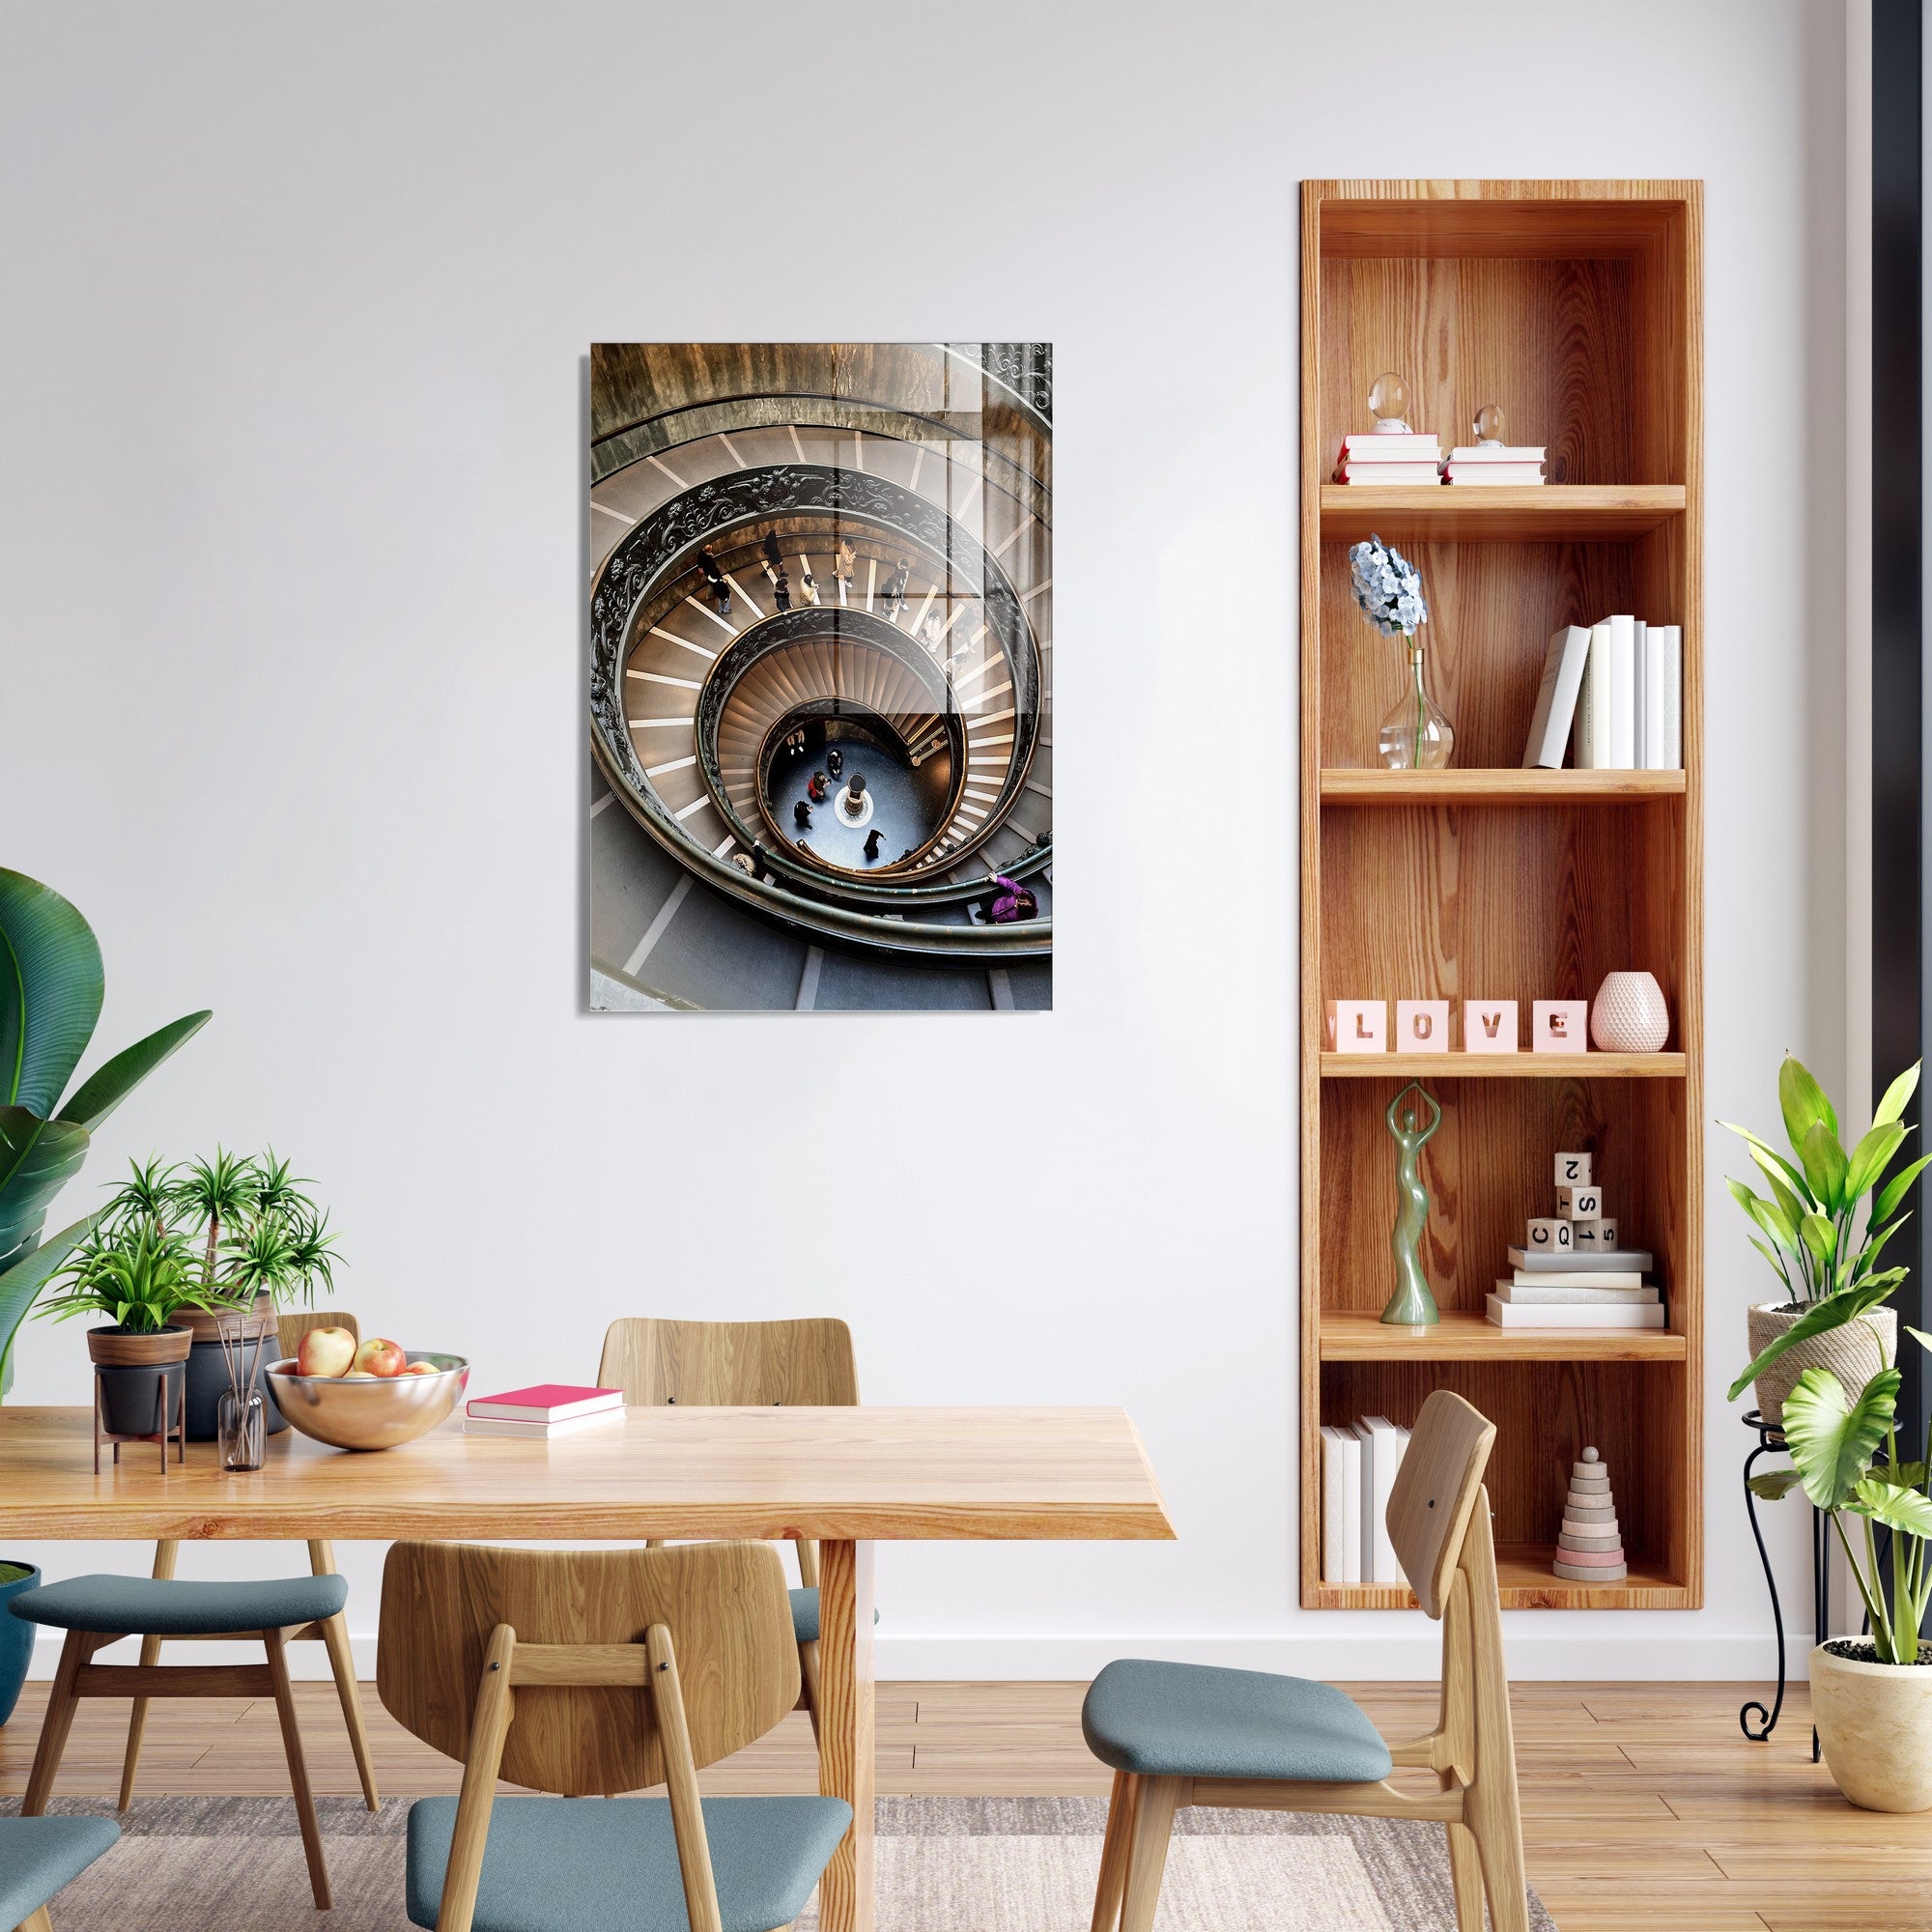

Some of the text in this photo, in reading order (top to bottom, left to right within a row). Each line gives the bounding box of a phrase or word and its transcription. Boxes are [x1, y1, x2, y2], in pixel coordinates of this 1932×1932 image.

[1566, 1160, 1579, 1179] 2
[1559, 1195, 1570, 1210] T
[1578, 1196, 1597, 1212] S
[1532, 1227, 1548, 1244] C
[1558, 1226, 1570, 1246] Q
[1578, 1230, 1595, 1240] 1
[1604, 1228, 1614, 1241] 5
